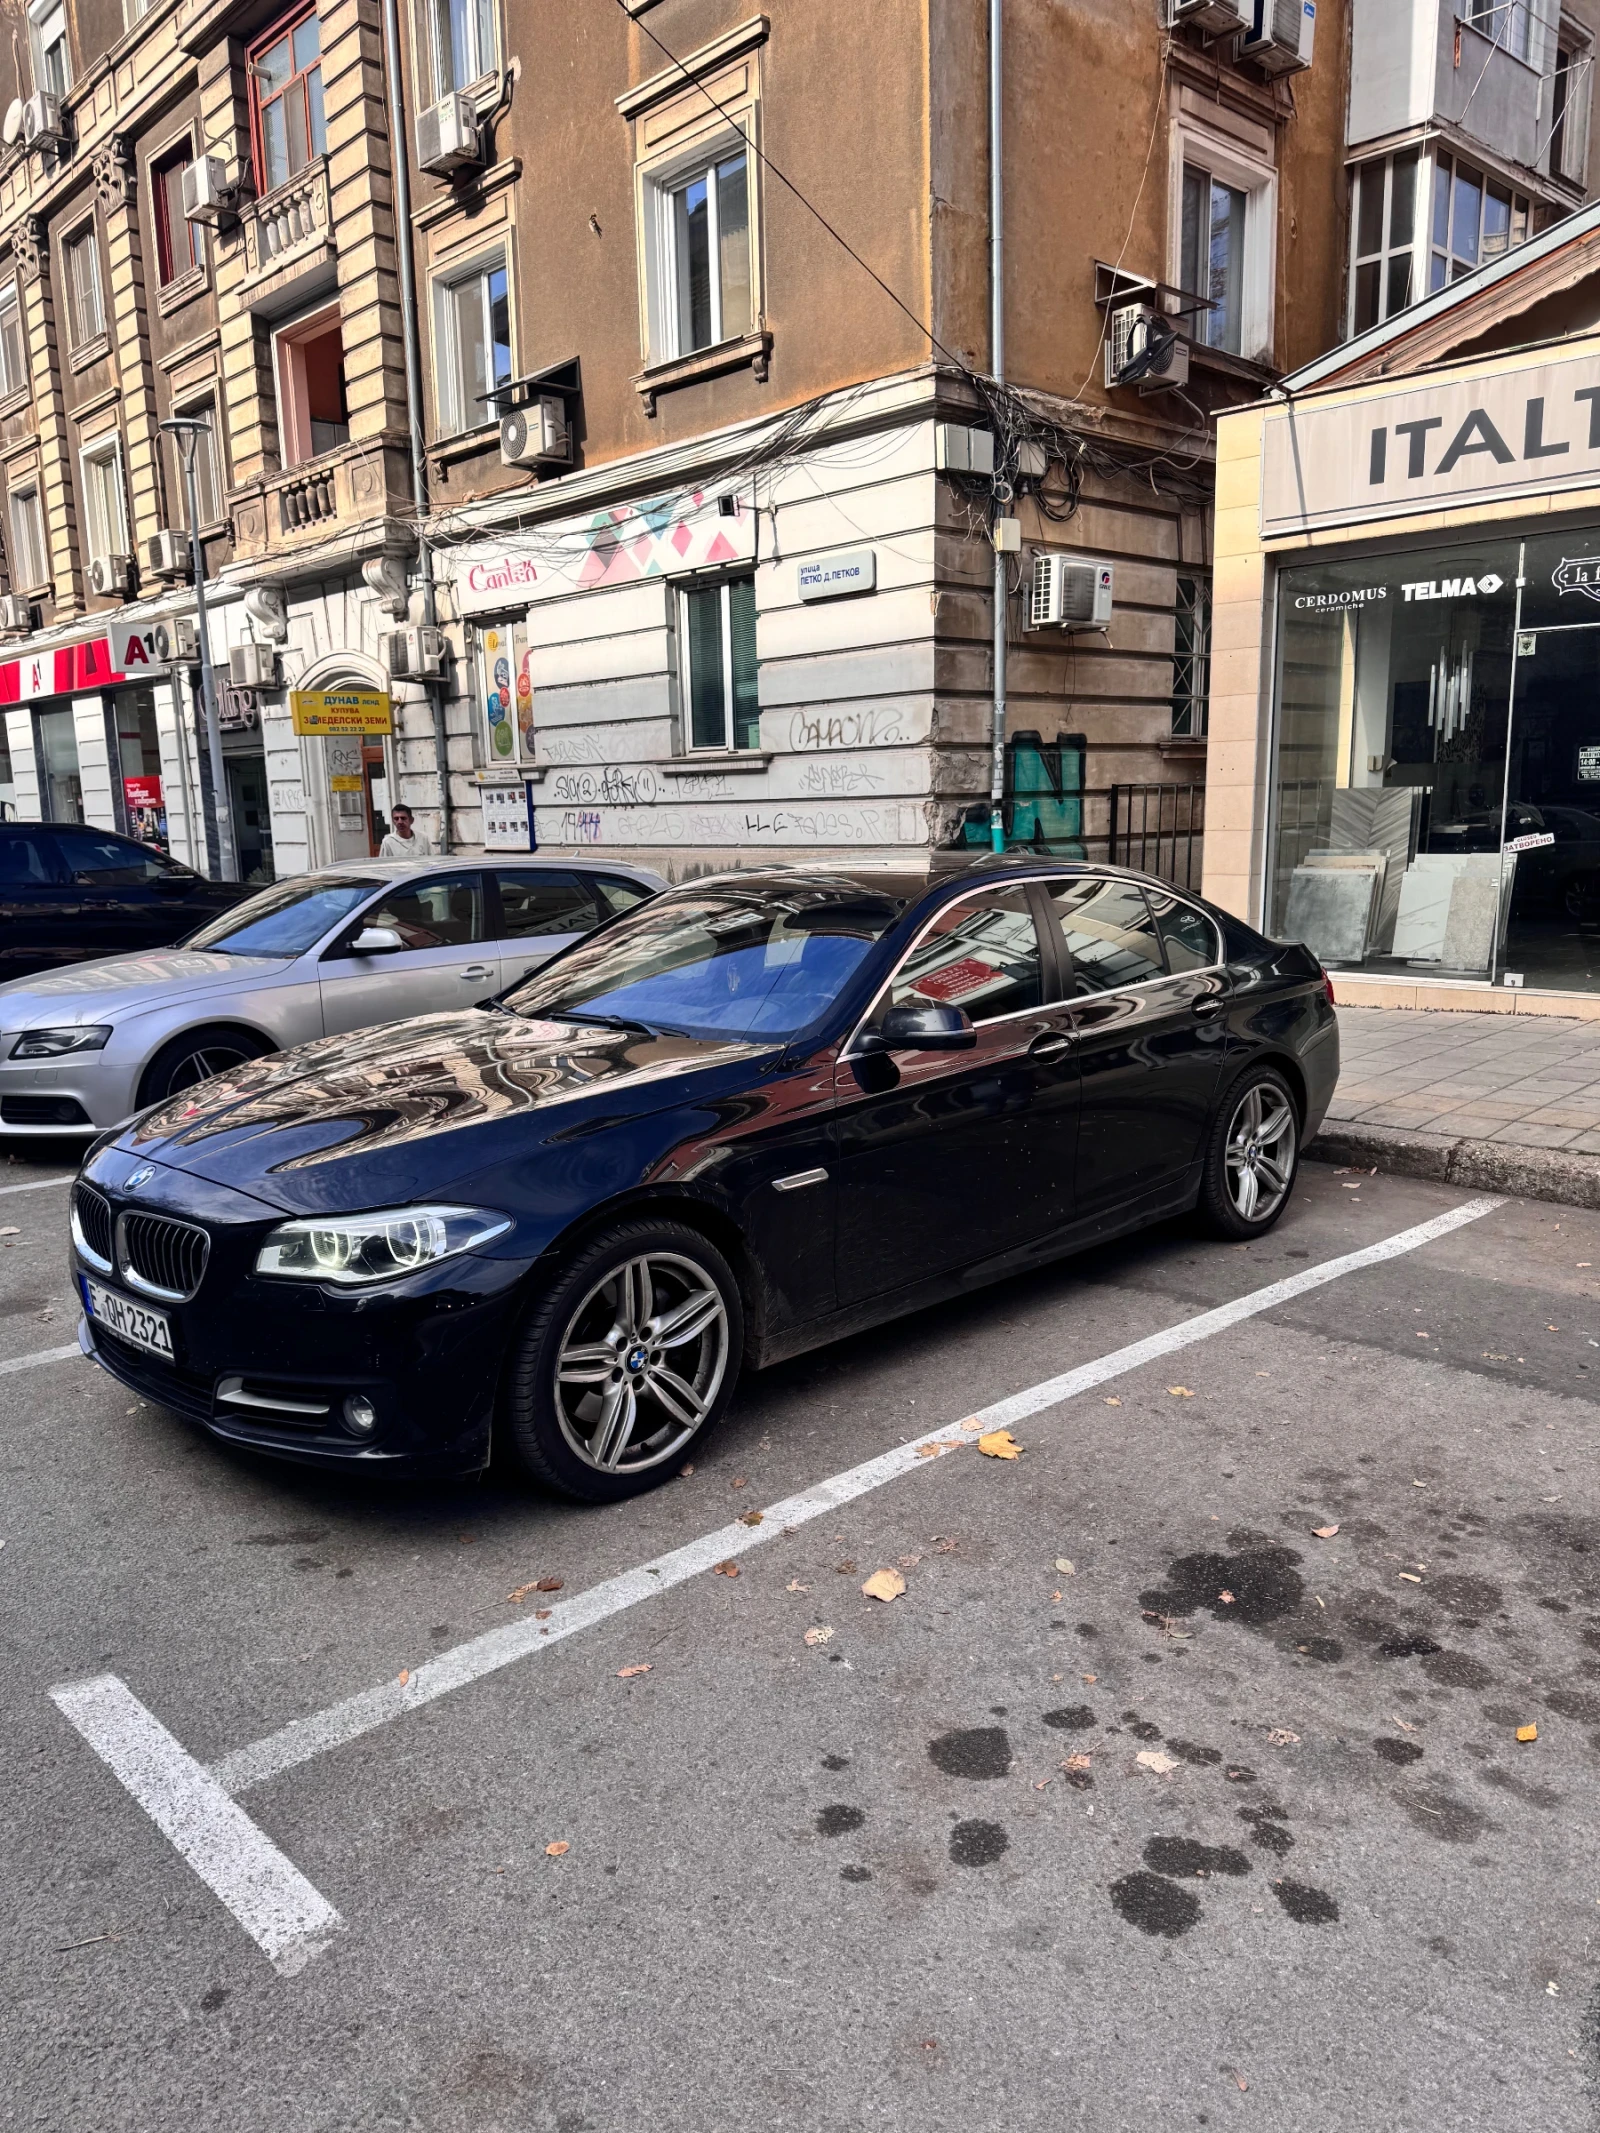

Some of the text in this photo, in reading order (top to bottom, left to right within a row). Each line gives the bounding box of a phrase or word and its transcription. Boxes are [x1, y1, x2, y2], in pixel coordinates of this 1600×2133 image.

[800, 564, 821, 576] улица
[800, 573, 823, 586] ПЕТКО
[1401, 577, 1477, 602] TELMA
[1294, 586, 1388, 609] CERDOMUS
[1315, 602, 1364, 614] ceramiche
[324, 696, 359, 706] ДУНАВ
[365, 716, 387, 725] ЗЕМИ
[1503, 836, 1553, 852] ЗАТВОРЕНО
